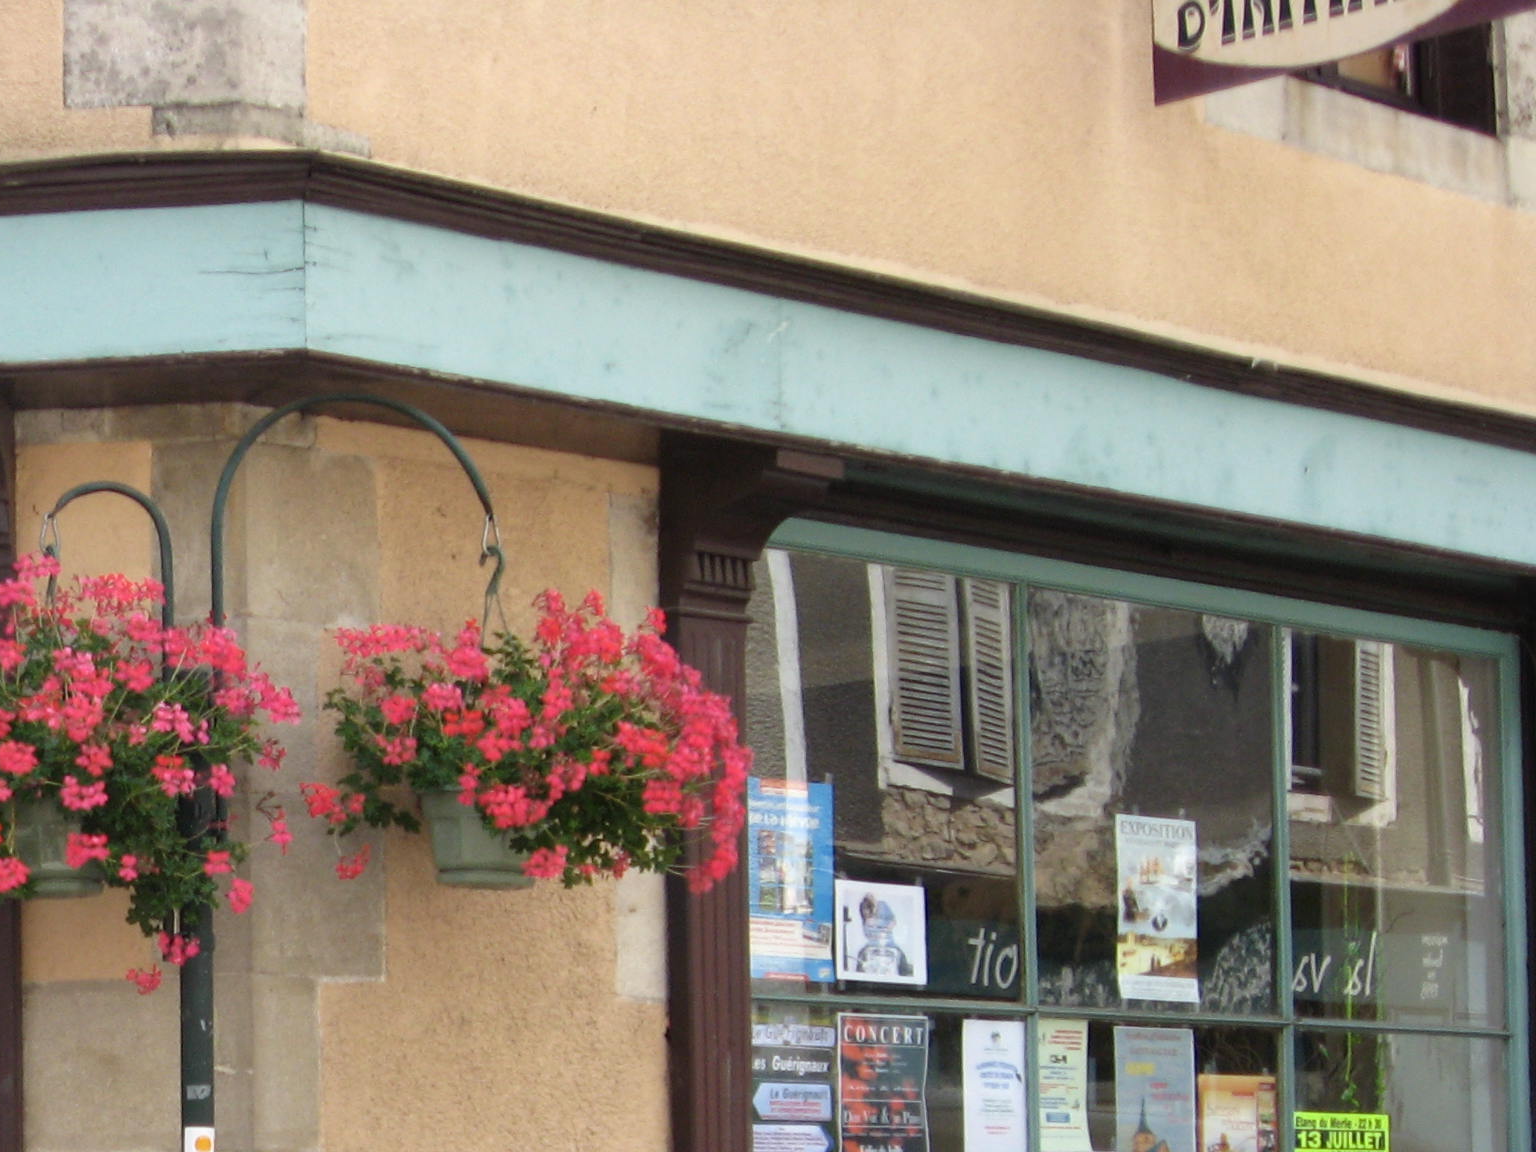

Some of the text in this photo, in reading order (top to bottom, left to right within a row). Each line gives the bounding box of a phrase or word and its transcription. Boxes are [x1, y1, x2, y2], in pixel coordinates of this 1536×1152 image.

[1120, 820, 1193, 841] EXPOSITION
[843, 1024, 924, 1046] CONCERT
[1296, 1130, 1382, 1150] 13 JUILLET
